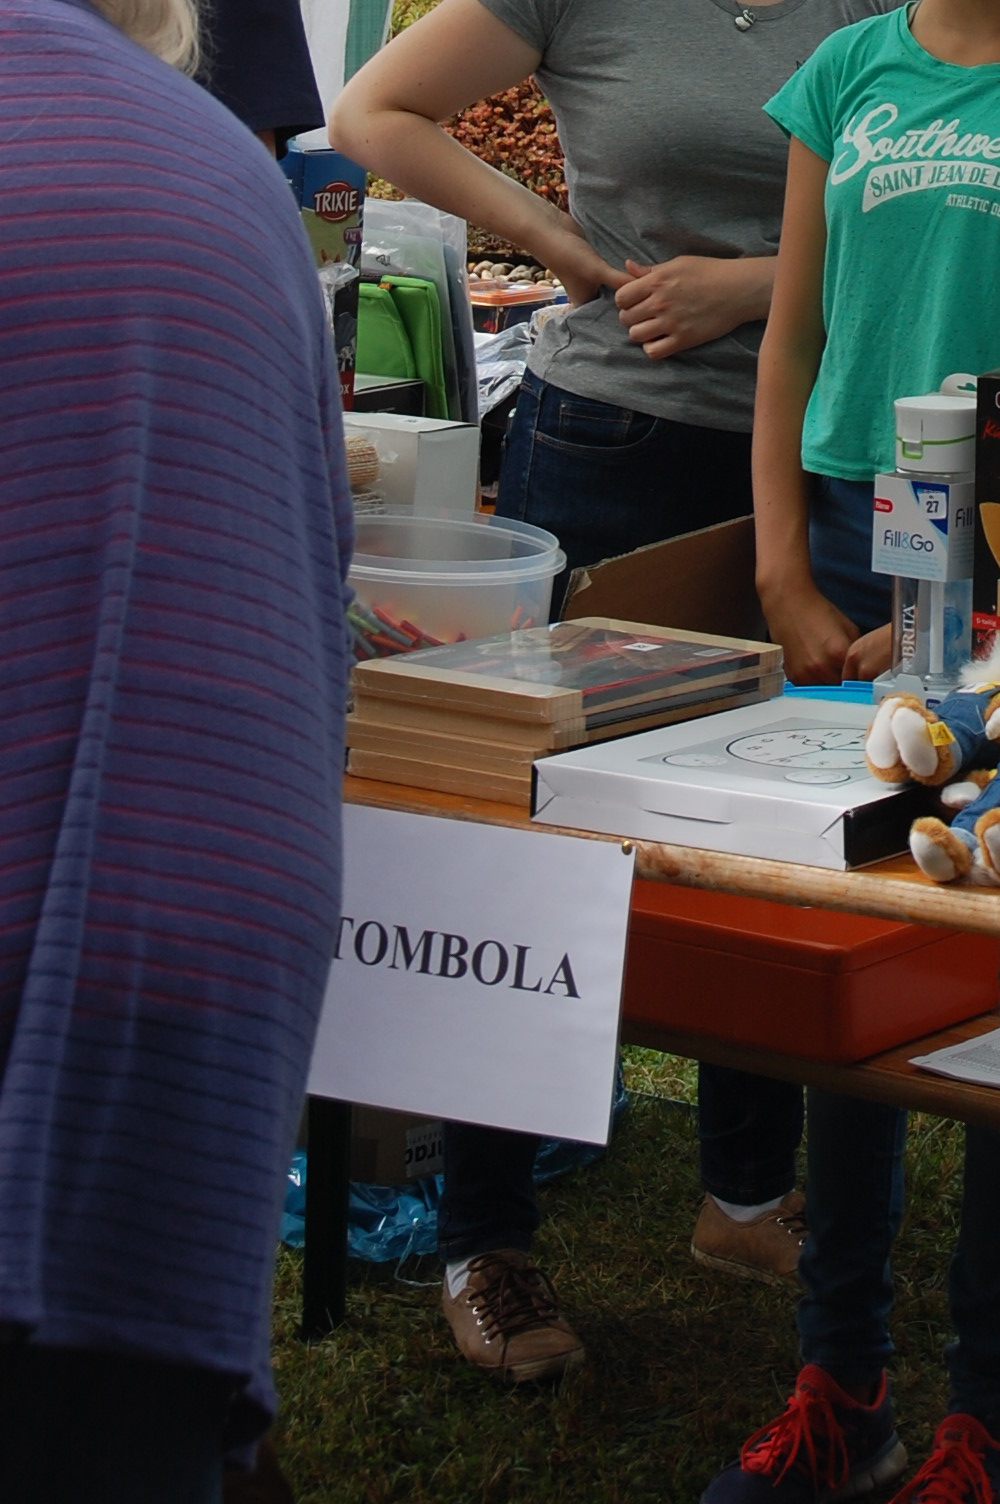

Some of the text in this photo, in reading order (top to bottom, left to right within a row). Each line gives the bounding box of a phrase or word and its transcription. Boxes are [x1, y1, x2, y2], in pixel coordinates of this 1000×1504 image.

[871, 165, 924, 198] SAINT
[928, 164, 964, 184] JEAN
[969, 165, 988, 184] DE
[314, 190, 358, 214] TRIXIE
[946, 194, 989, 213] ATHLETIC
[926, 500, 939, 514] 27
[902, 604, 916, 658] BRITA
[333, 916, 581, 999] TOMBOLA
